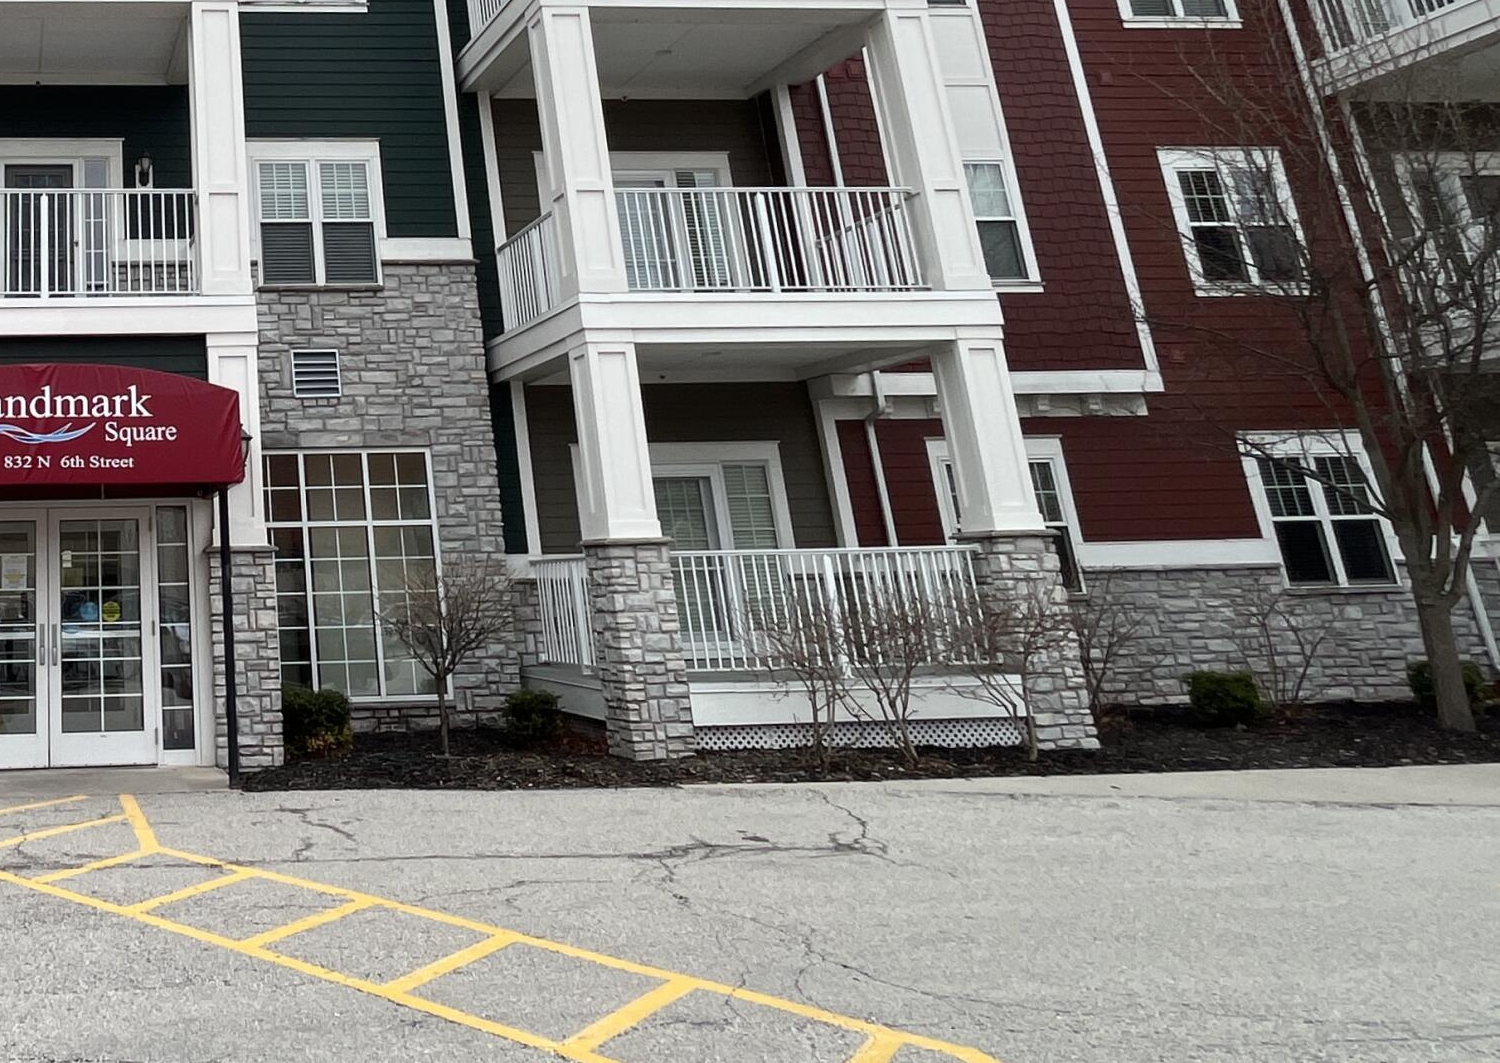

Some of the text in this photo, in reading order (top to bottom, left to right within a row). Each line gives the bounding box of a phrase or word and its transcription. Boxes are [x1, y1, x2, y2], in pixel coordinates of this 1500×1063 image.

[104, 421, 177, 447] Square
[4, 455, 134, 469] 832 N 6th Street
